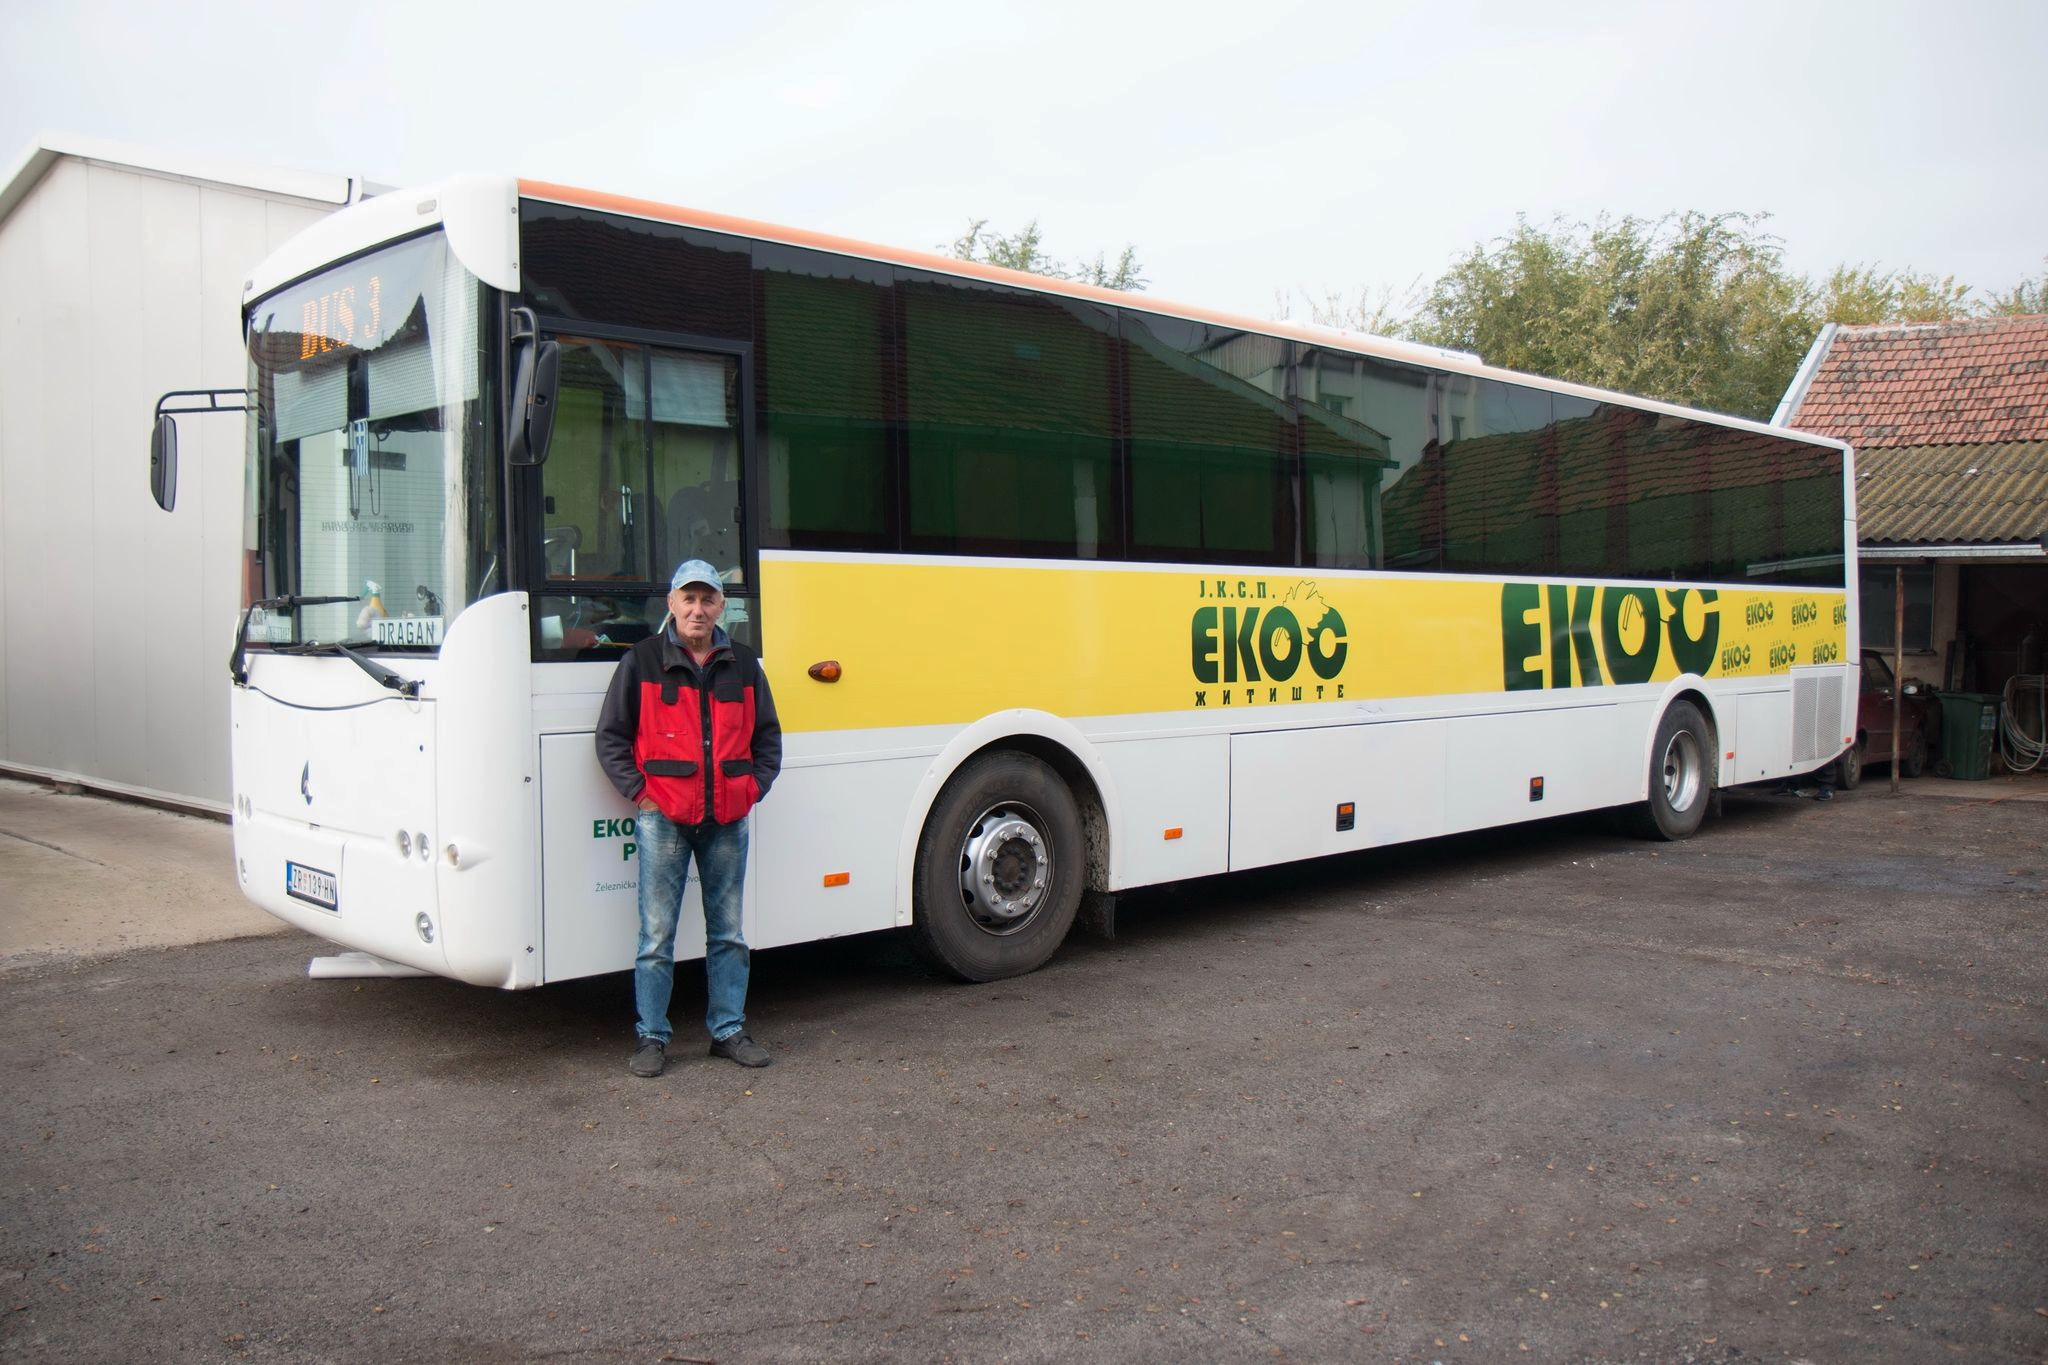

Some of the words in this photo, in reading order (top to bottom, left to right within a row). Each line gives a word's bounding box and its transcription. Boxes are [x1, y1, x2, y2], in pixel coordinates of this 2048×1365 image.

[301, 287, 355, 359] BUS
[379, 621, 434, 645] DRAGAN
[1195, 684, 1344, 706] ЖИТИШТЕ
